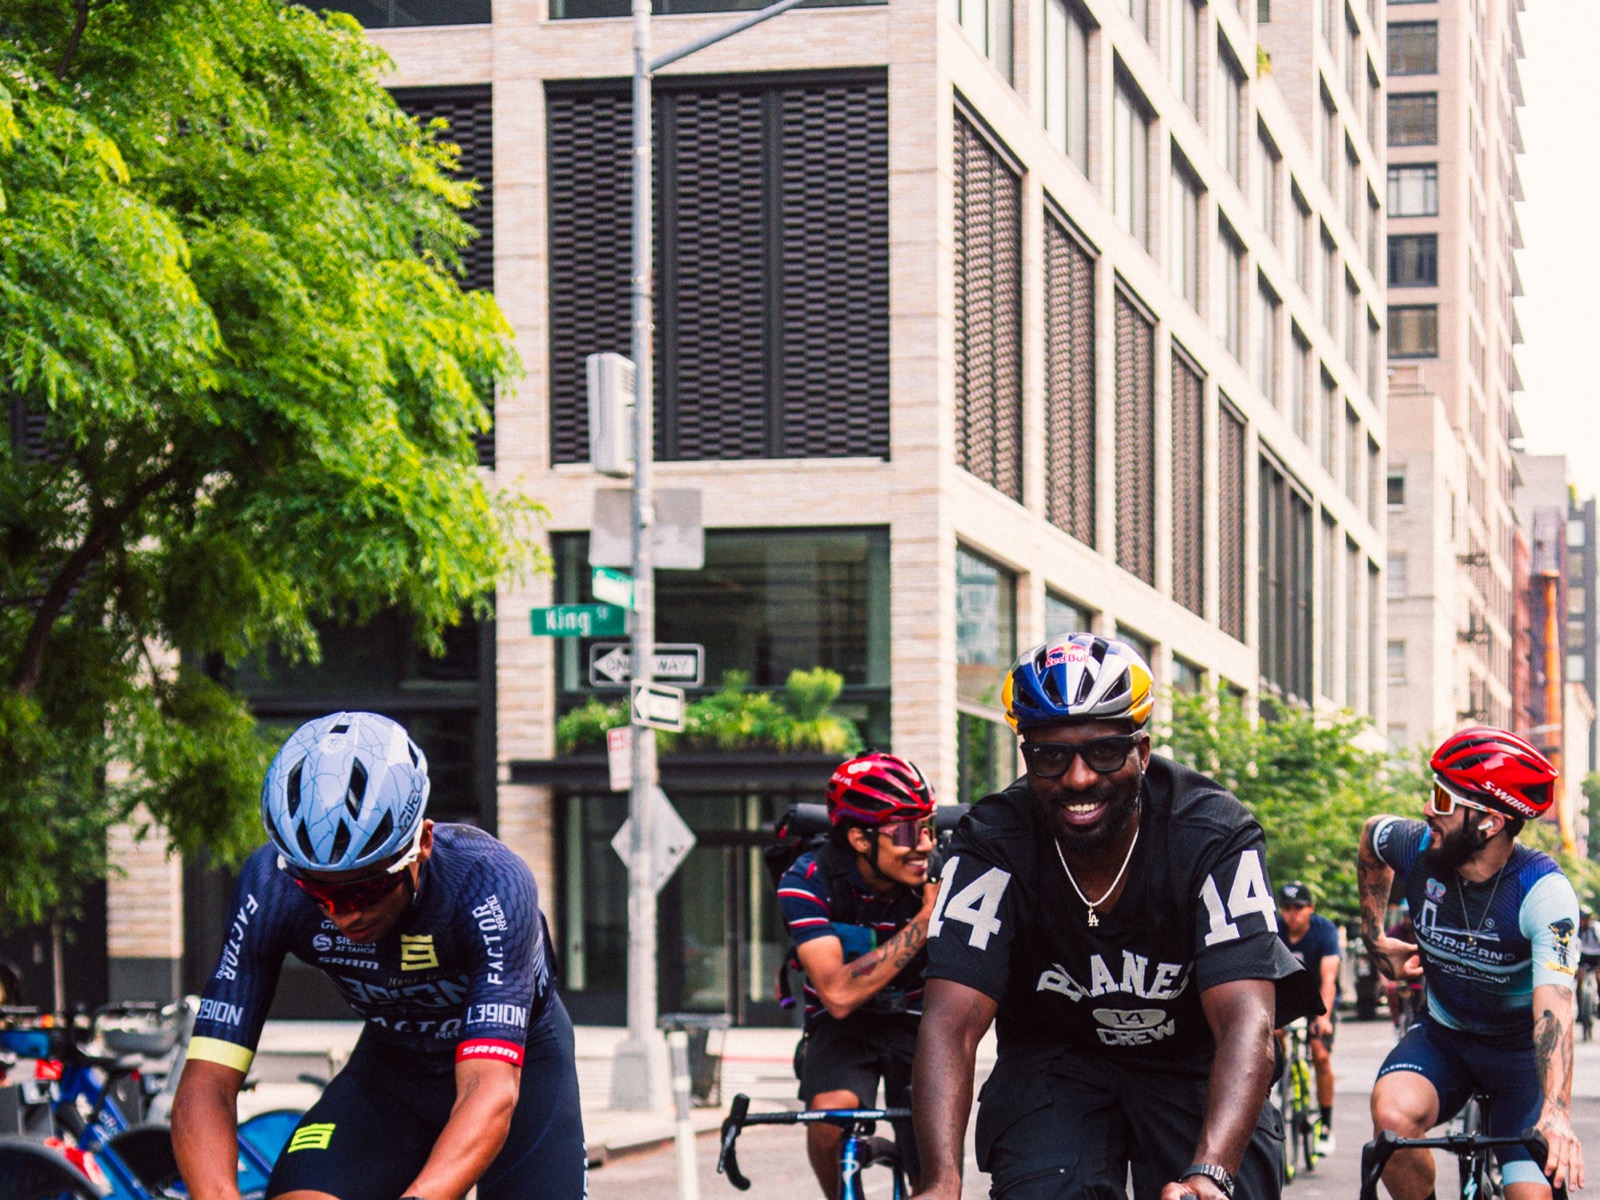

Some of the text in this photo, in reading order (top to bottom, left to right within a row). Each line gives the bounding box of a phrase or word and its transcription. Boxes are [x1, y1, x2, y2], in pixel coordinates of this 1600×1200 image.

[545, 607, 591, 637] King
[657, 659, 688, 672] WAY
[1046, 653, 1089, 667] Red Bull
[1481, 780, 1540, 818] S-WORKS
[926, 855, 1012, 951] 14
[1198, 849, 1279, 947] 14
[222, 893, 260, 981] FACTOR
[472, 902, 504, 985] FACTOR
[318, 956, 379, 971] SRAM
[197, 998, 244, 1027] 39ION
[1115, 1011, 1146, 1026] 14
[1095, 1018, 1176, 1046] CREW
[462, 1045, 519, 1060] SRAM
